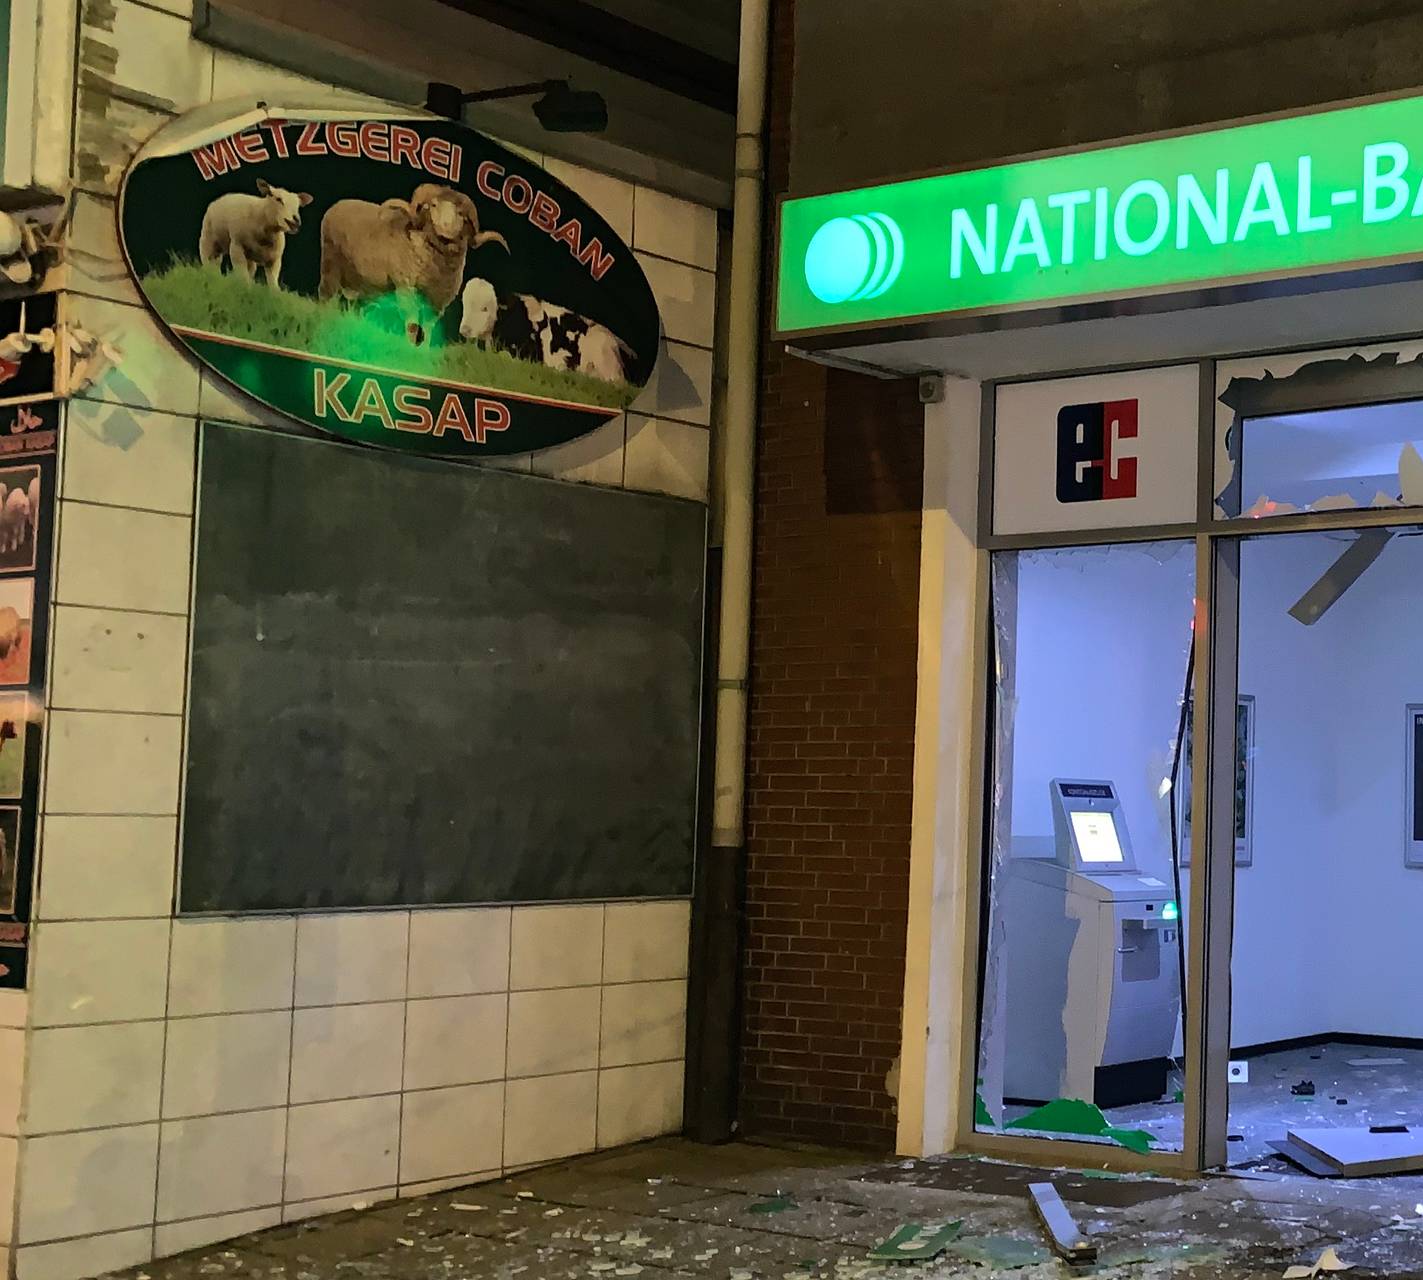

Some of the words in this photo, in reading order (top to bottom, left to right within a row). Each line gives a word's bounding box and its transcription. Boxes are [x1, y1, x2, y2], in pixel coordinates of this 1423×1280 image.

[191, 118, 463, 182] METZGEREI
[476, 159, 615, 281] COBAN
[312, 368, 511, 445] KASAP
